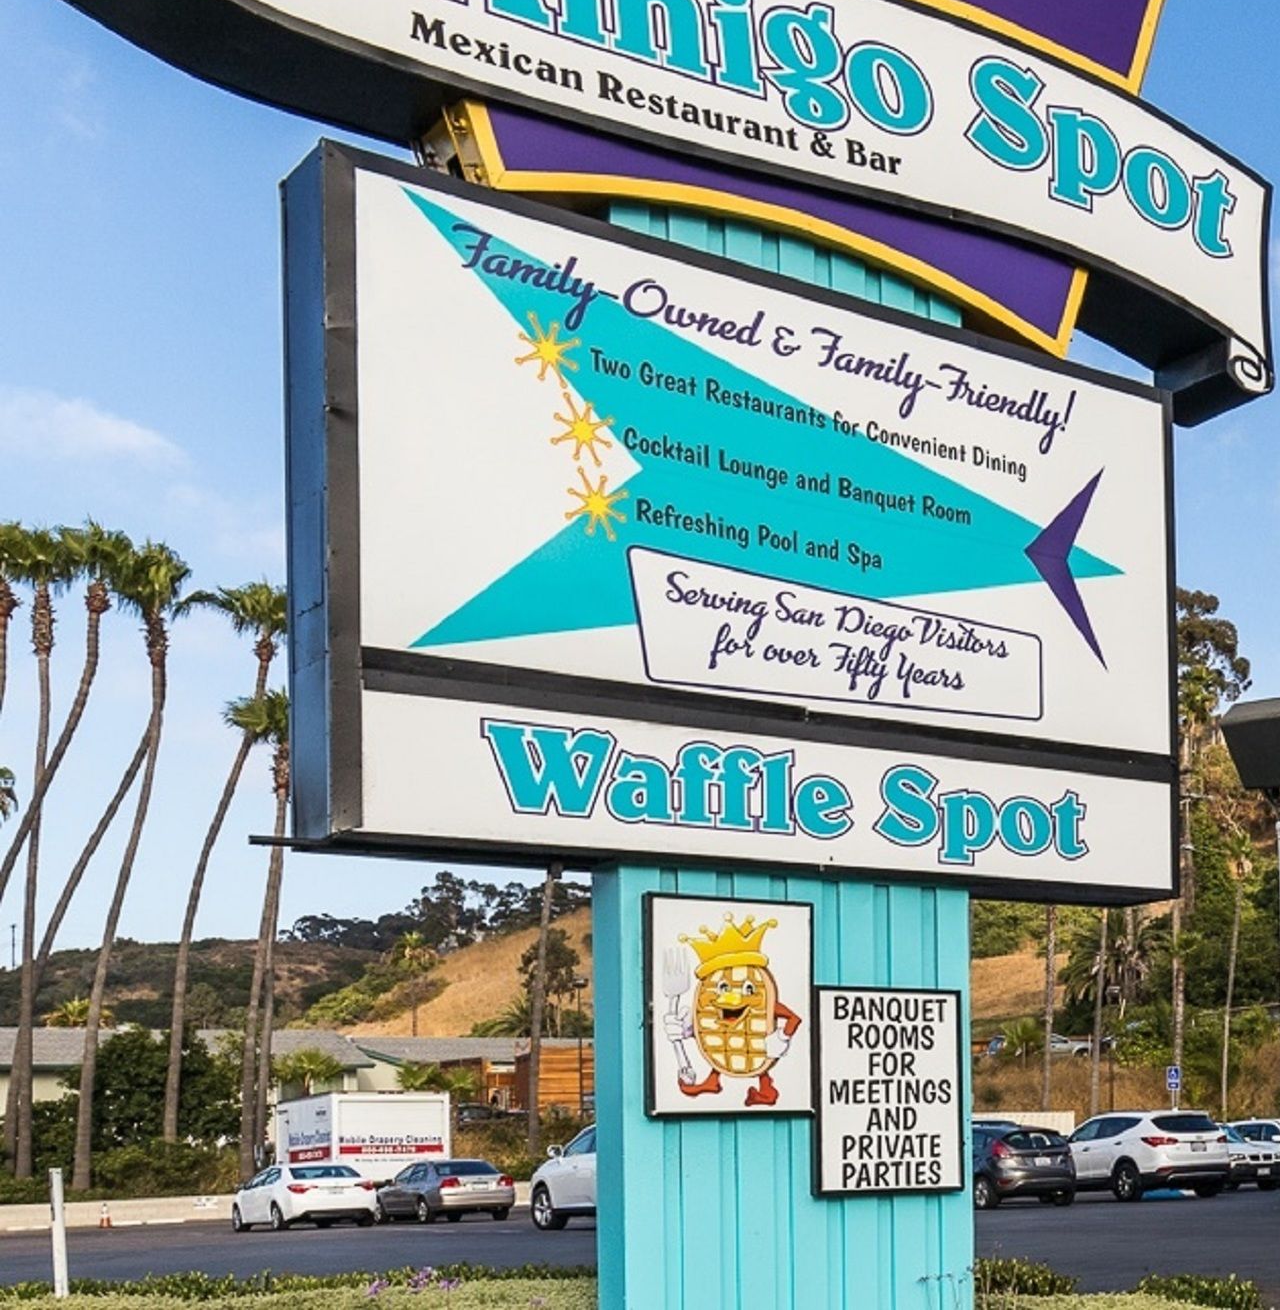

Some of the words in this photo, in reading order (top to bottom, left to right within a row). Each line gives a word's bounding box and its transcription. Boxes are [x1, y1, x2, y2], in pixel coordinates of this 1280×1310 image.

[411, 12, 583, 91] Mexican
[598, 71, 798, 150] Restaurant
[811, 132, 834, 158] &
[847, 139, 901, 174] Bar
[964, 56, 1237, 258] Spot
[452, 224, 764, 345] Family-Owned
[774, 327, 800, 356] &
[812, 328, 1076, 454] Family-Friendly!
[591, 348, 630, 379] Two
[640, 362, 696, 396] Great
[706, 378, 826, 428] Restaurants
[833, 411, 859, 437] for
[867, 421, 965, 461] Convenient
[974, 447, 1025, 482] Dining
[624, 428, 709, 468] Cocktail
[719, 449, 788, 489] Lounge
[796, 474, 830, 494] and
[839, 478, 915, 512] Banquet
[923, 496, 970, 525] Room
[637, 499, 749, 549] Refreshing
[759, 525, 797, 553] Pool
[806, 541, 838, 561] and
[848, 543, 881, 572] Spa
[667, 572, 767, 640] Serving
[776, 592, 823, 626] San
[835, 606, 912, 661] Diego
[912, 617, 1007, 657] Visitors
[709, 624, 753, 669] for
[764, 646, 820, 667] over
[829, 643, 887, 700] Fifty
[898, 653, 963, 698] Years
[480, 718, 861, 840] Waffle
[872, 765, 1089, 866] Spot
[834, 996, 947, 1023] BANQUET
[848, 1023, 934, 1050] ROOMS
[830, 1079, 951, 1104] MEETINGS
[869, 1052, 915, 1076] FOR
[843, 1134, 940, 1159] PRIVATE
[867, 1107, 916, 1132] AND
[843, 1161, 941, 1188] PARTIES
